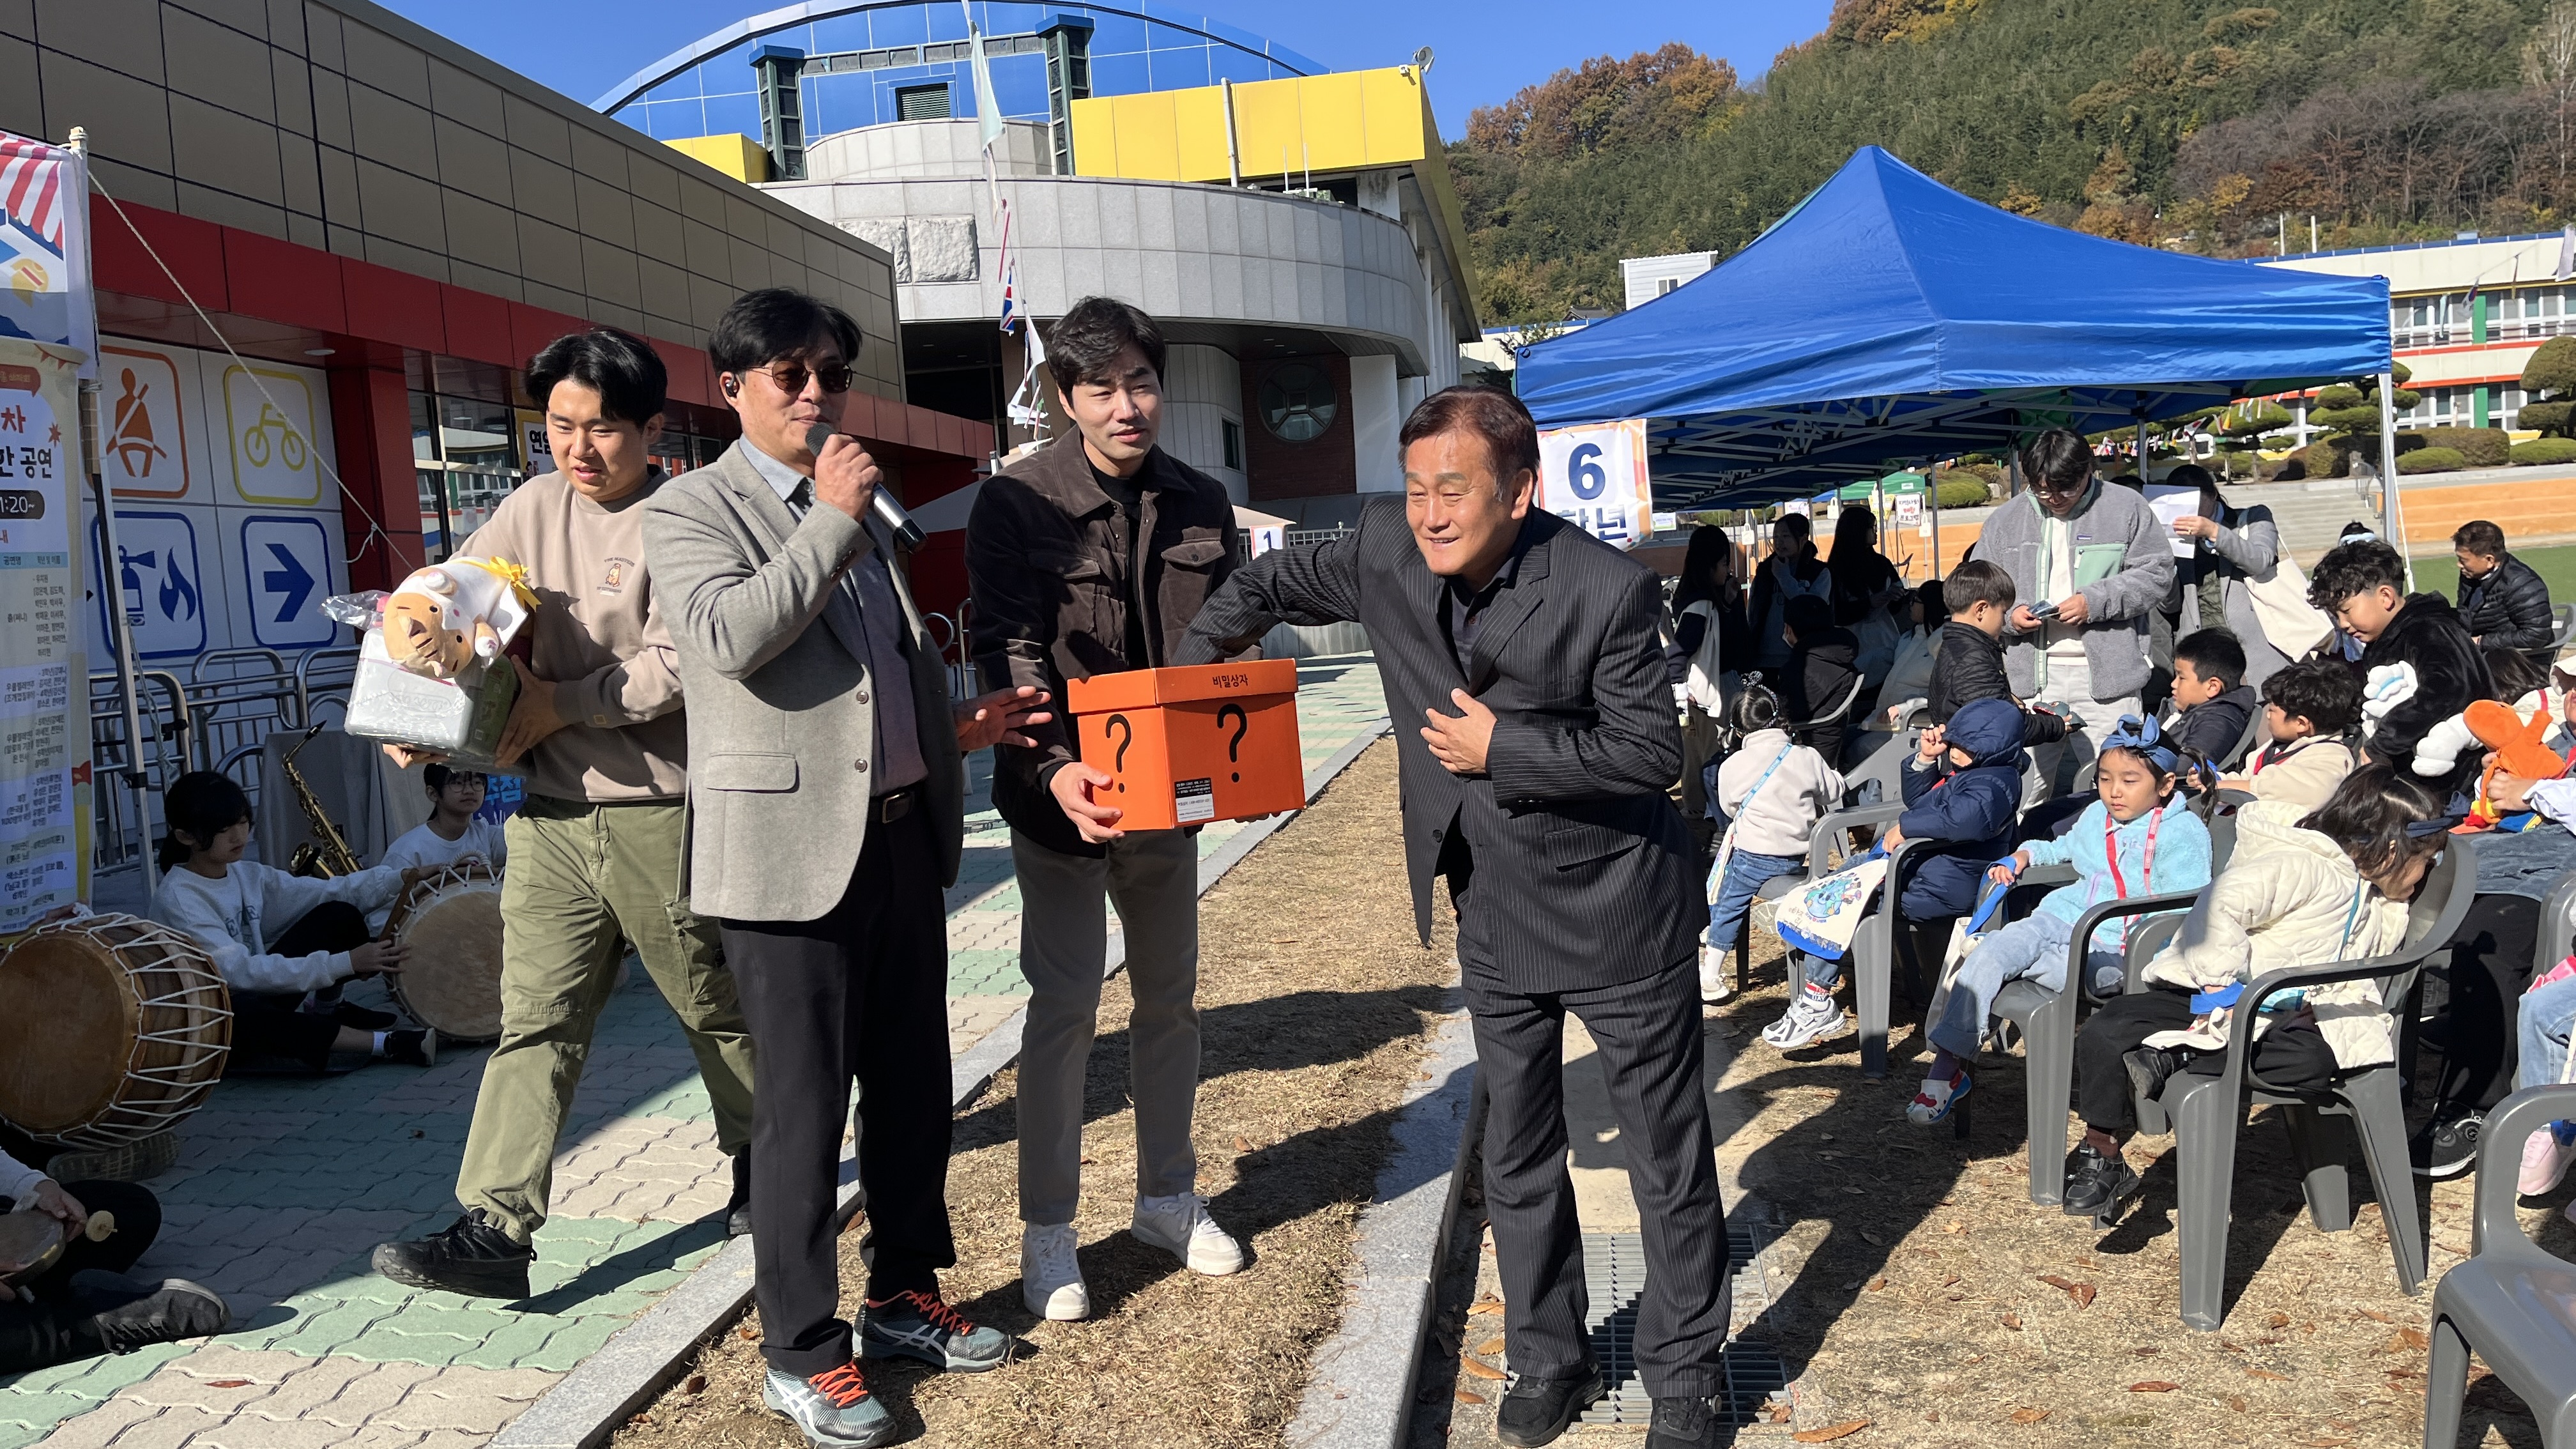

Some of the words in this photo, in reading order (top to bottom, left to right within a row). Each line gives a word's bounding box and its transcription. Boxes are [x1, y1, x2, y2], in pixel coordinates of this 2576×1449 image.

[20, 447, 52, 479] 공연
[1568, 443, 1606, 500] 6
[1212, 673, 1248, 689] 비밀상자
